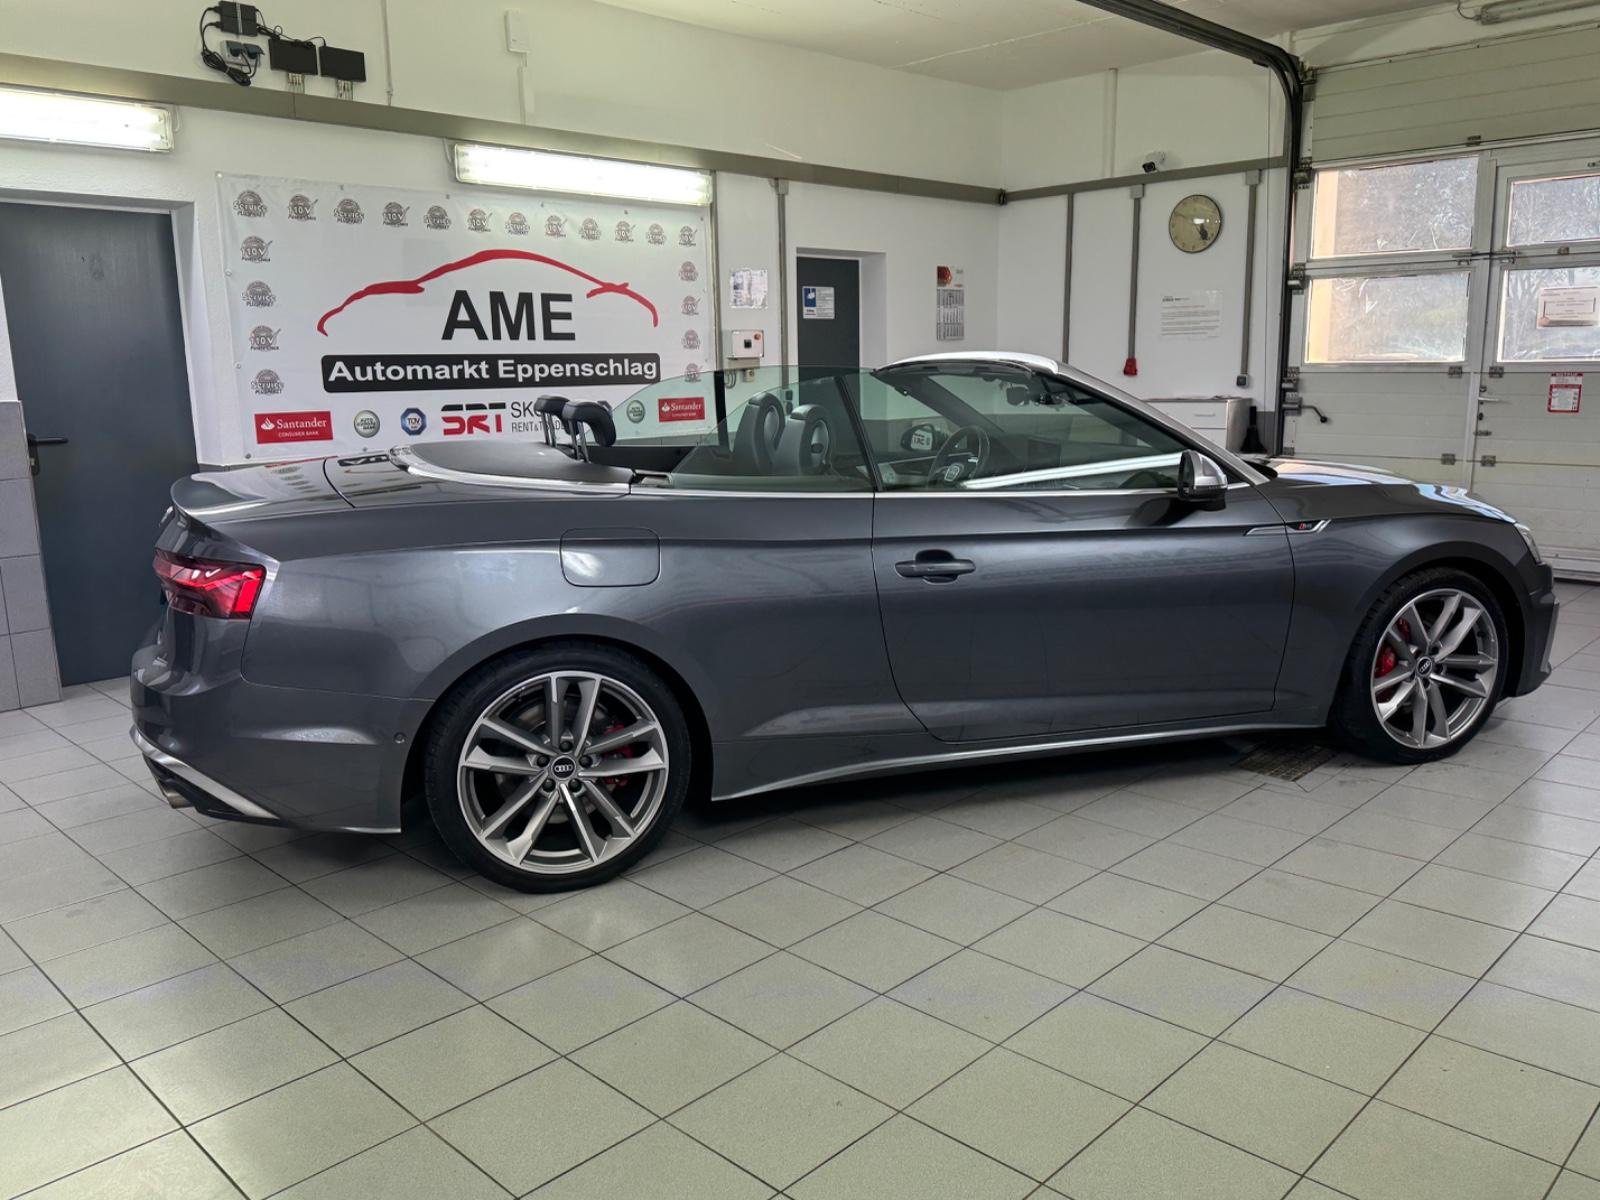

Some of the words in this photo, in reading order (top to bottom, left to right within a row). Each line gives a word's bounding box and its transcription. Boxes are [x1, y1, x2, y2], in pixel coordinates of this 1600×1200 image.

[441, 290, 576, 341] AME
[328, 360, 489, 382] Automarkt
[498, 358, 656, 382] Eppenschlag
[671, 401, 702, 411] Santander
[276, 417, 327, 430] Santander
